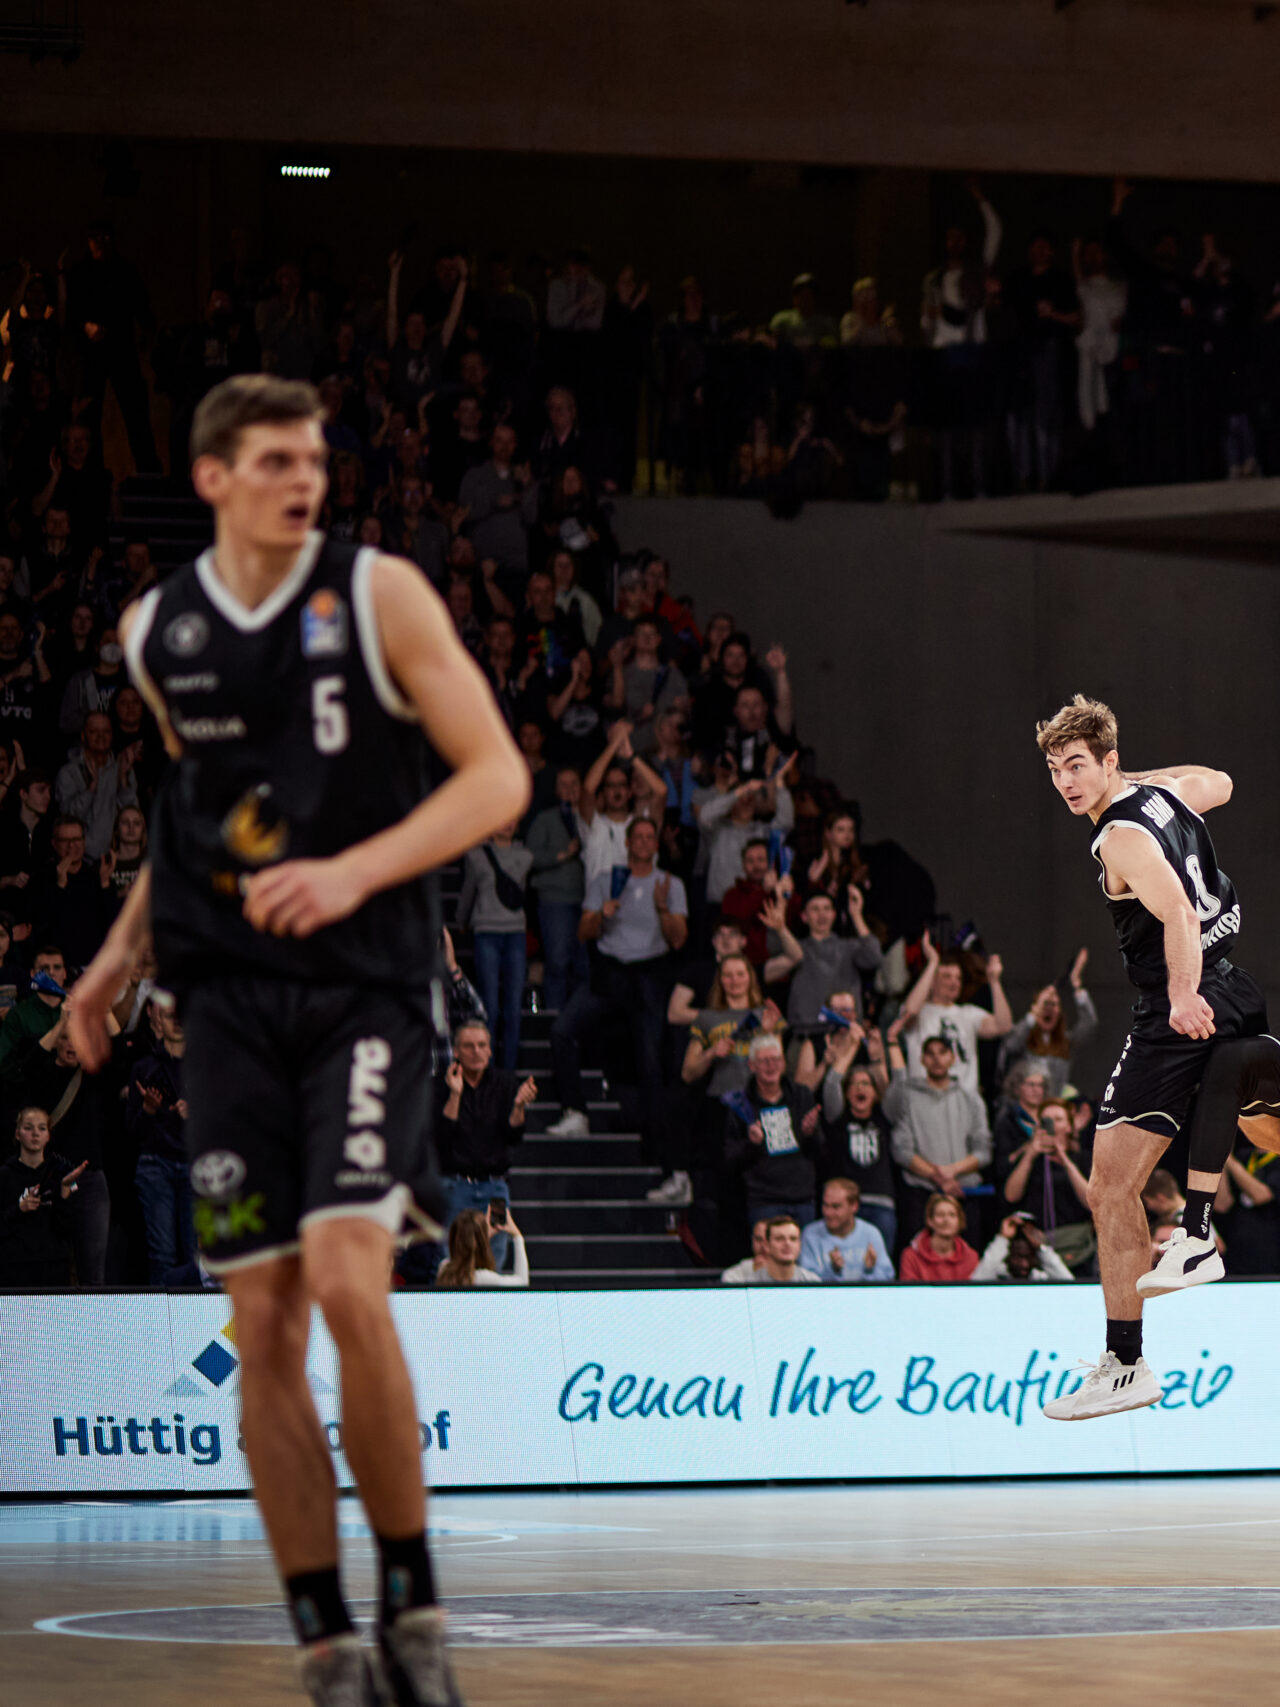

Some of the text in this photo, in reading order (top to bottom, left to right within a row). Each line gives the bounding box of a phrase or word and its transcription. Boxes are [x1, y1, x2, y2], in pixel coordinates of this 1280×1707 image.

[312, 676, 350, 755] 5
[347, 1036, 392, 1126] VTG
[1202, 1203, 1211, 1225] CRAFT
[558, 1361, 743, 1423] Genau
[769, 1346, 882, 1418] Ihre
[52, 1413, 222, 1466] Hüttig
